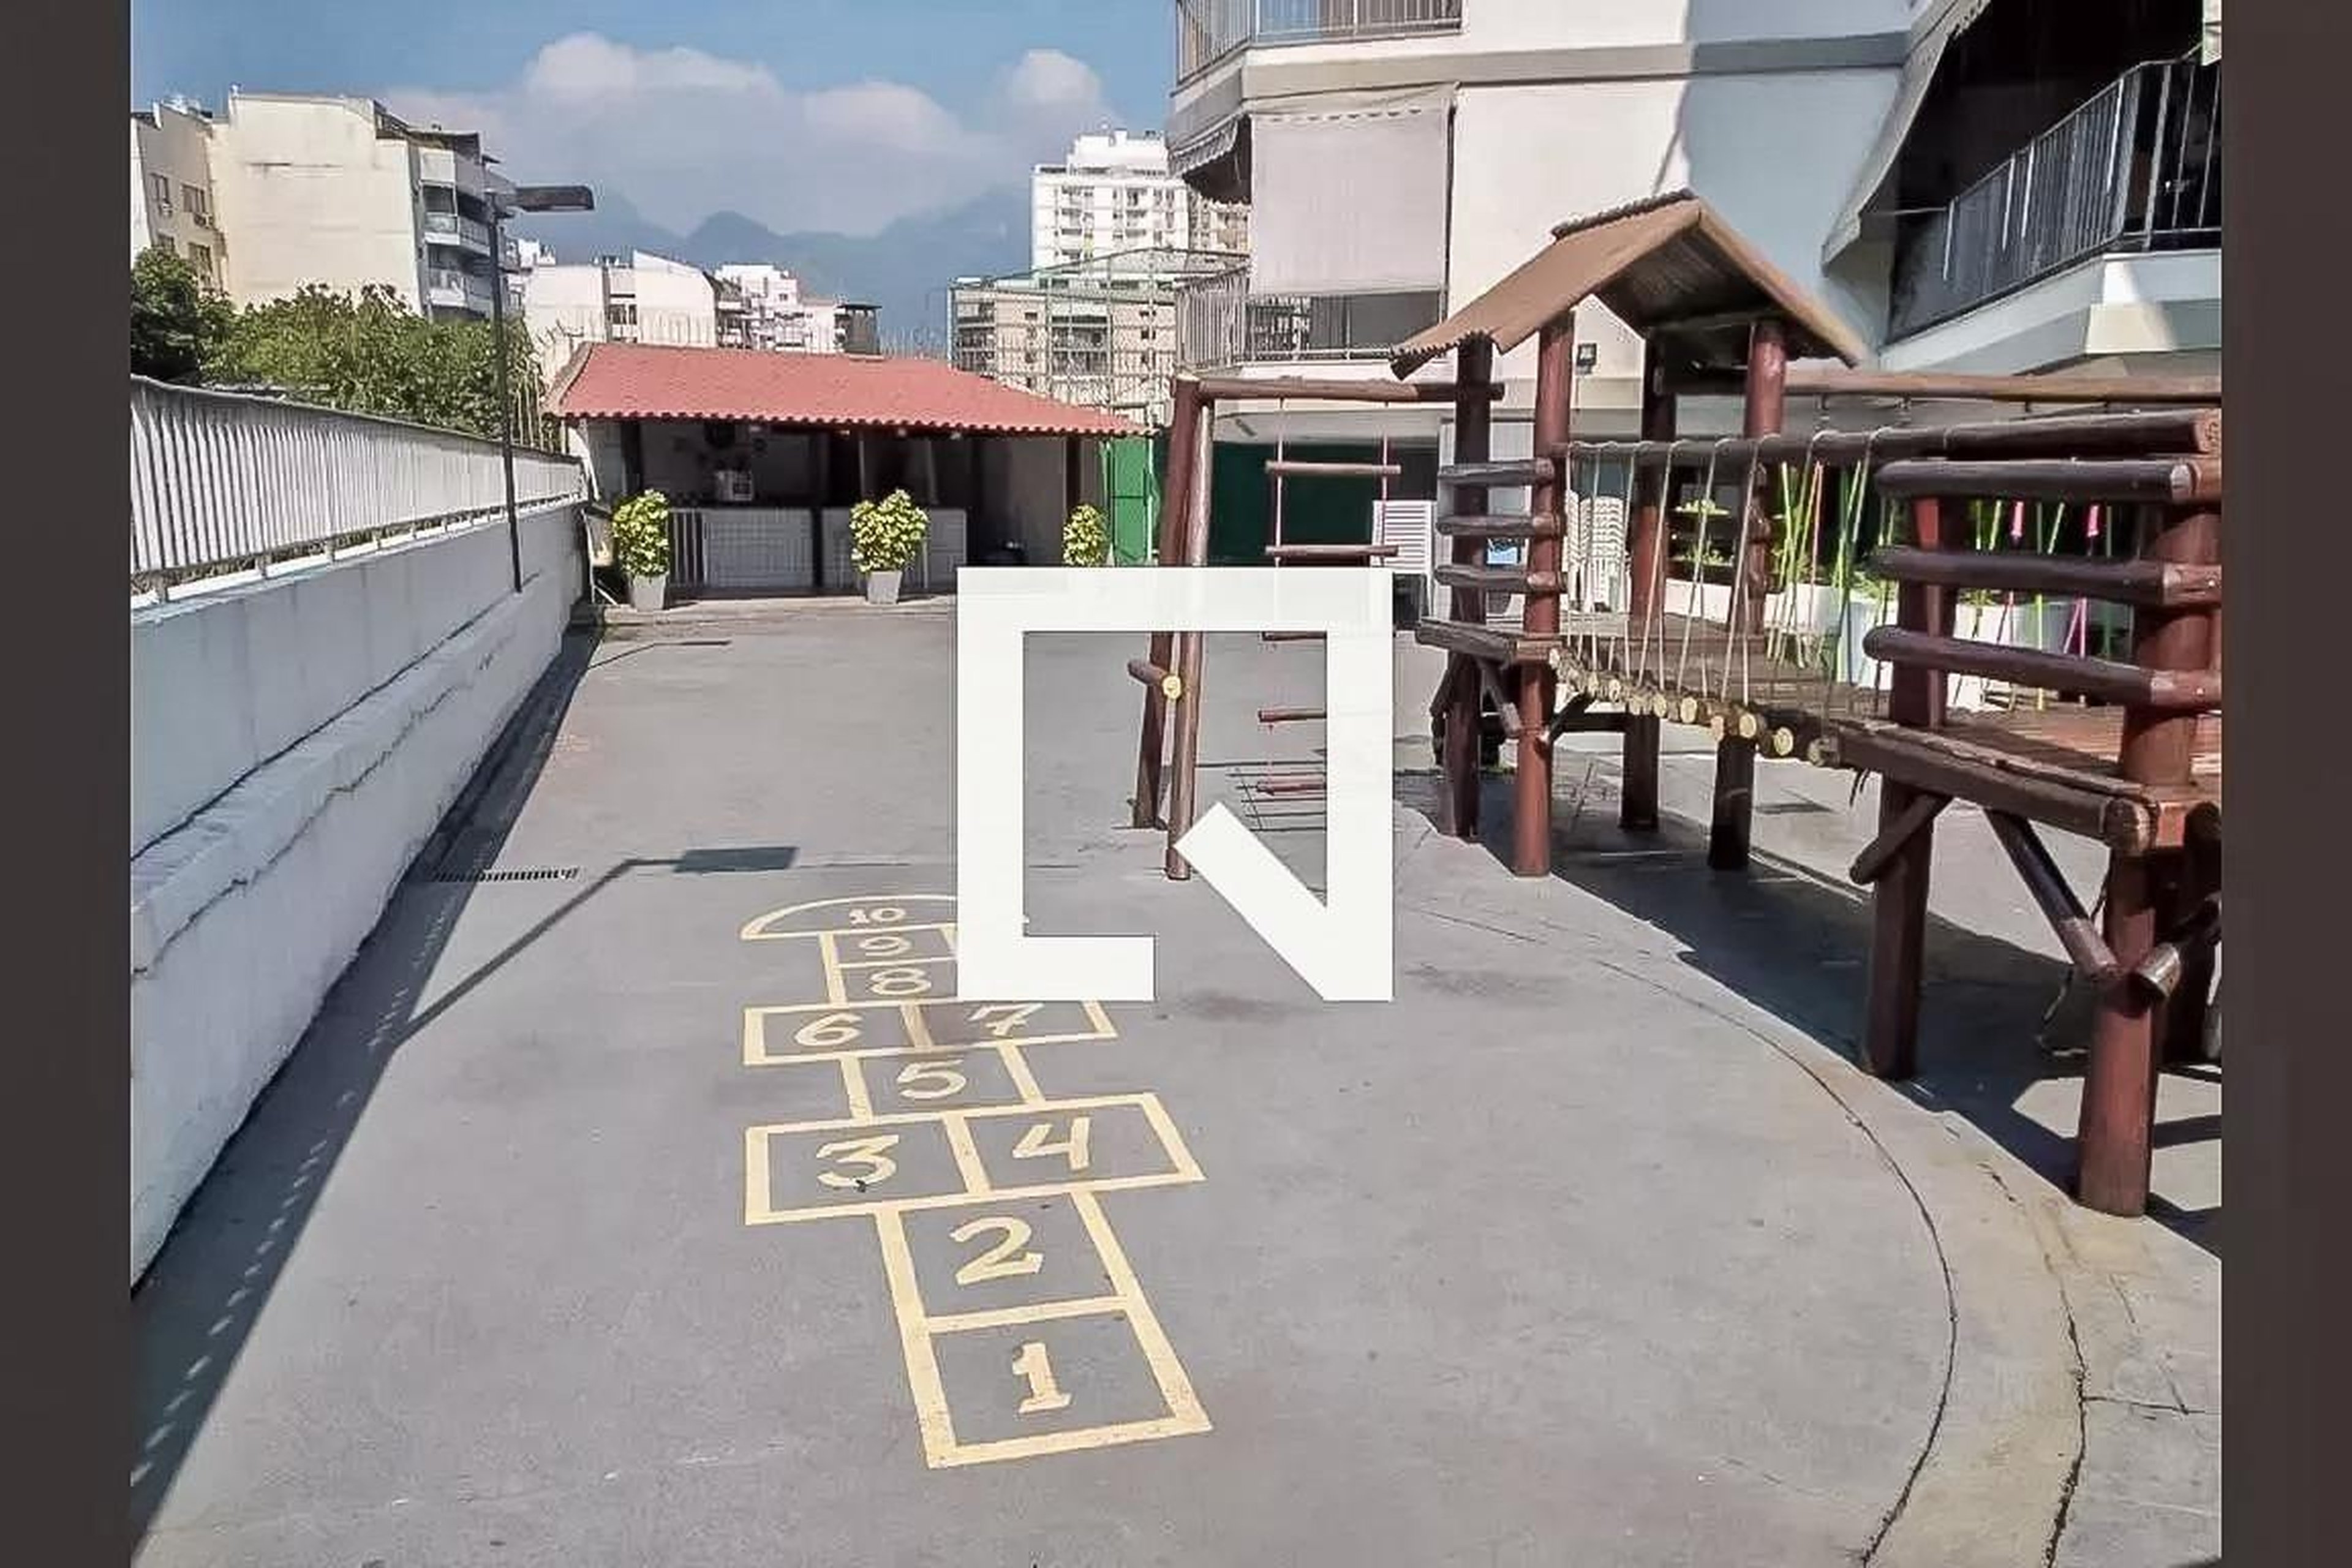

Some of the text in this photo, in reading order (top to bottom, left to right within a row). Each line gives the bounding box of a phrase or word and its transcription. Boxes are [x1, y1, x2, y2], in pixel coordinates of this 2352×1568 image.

[849, 907, 907, 924] 10
[859, 937, 913, 956] 9
[870, 968, 932, 996] 8
[794, 1014, 862, 1046] 6
[967, 1001, 1044, 1036] 7
[896, 1059, 967, 1099] 5
[816, 1134, 900, 1188] 3
[1012, 1117, 1090, 1170] 4
[949, 1216, 1043, 1286] 2
[1012, 1342, 1072, 1414] 1
